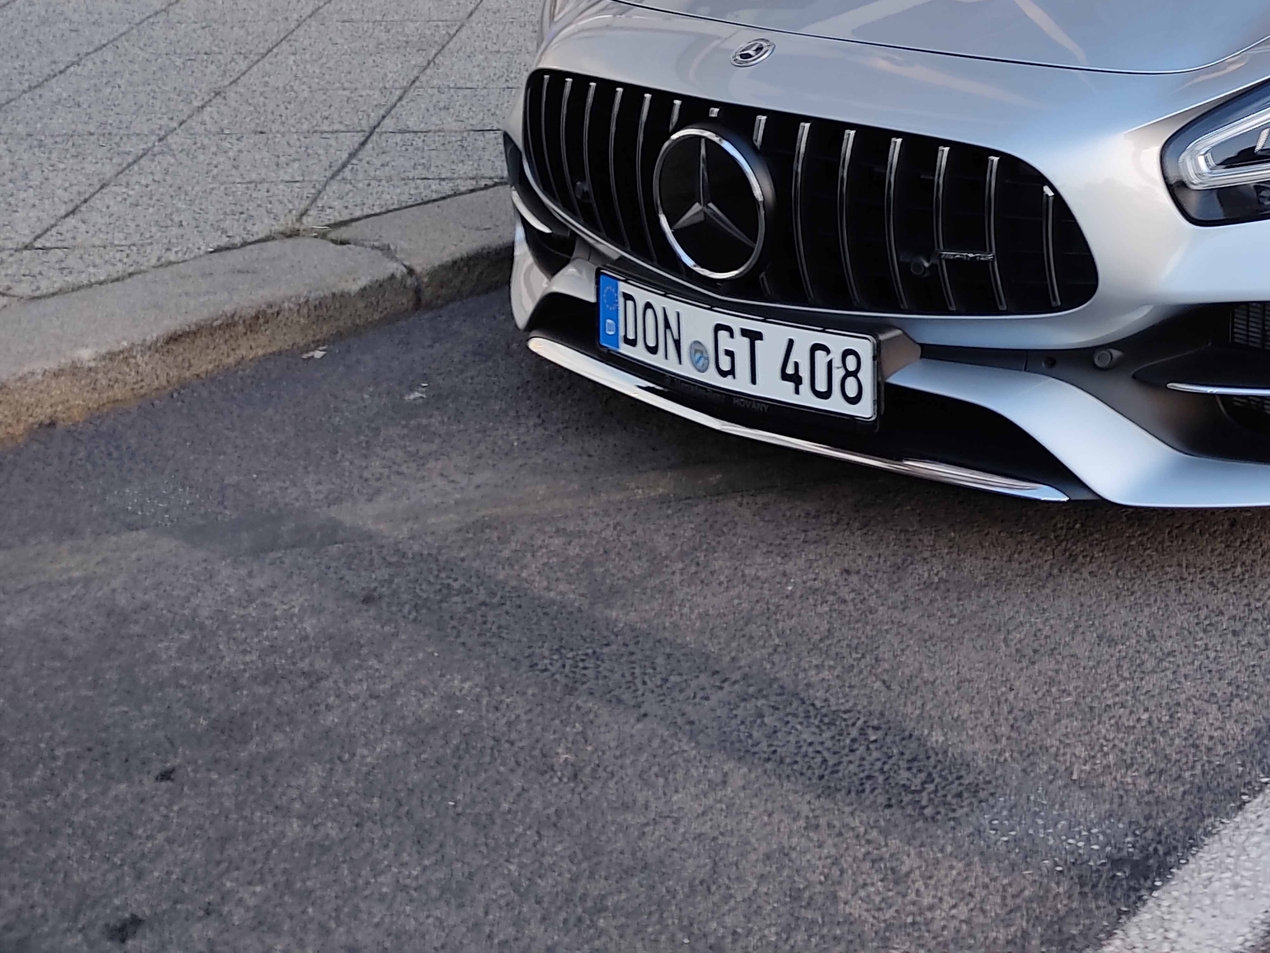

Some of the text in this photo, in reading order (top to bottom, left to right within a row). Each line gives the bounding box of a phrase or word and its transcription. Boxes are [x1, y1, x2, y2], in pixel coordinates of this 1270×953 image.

[621, 291, 682, 365] DON
[713, 323, 763, 385] GT
[781, 338, 863, 405] 408
